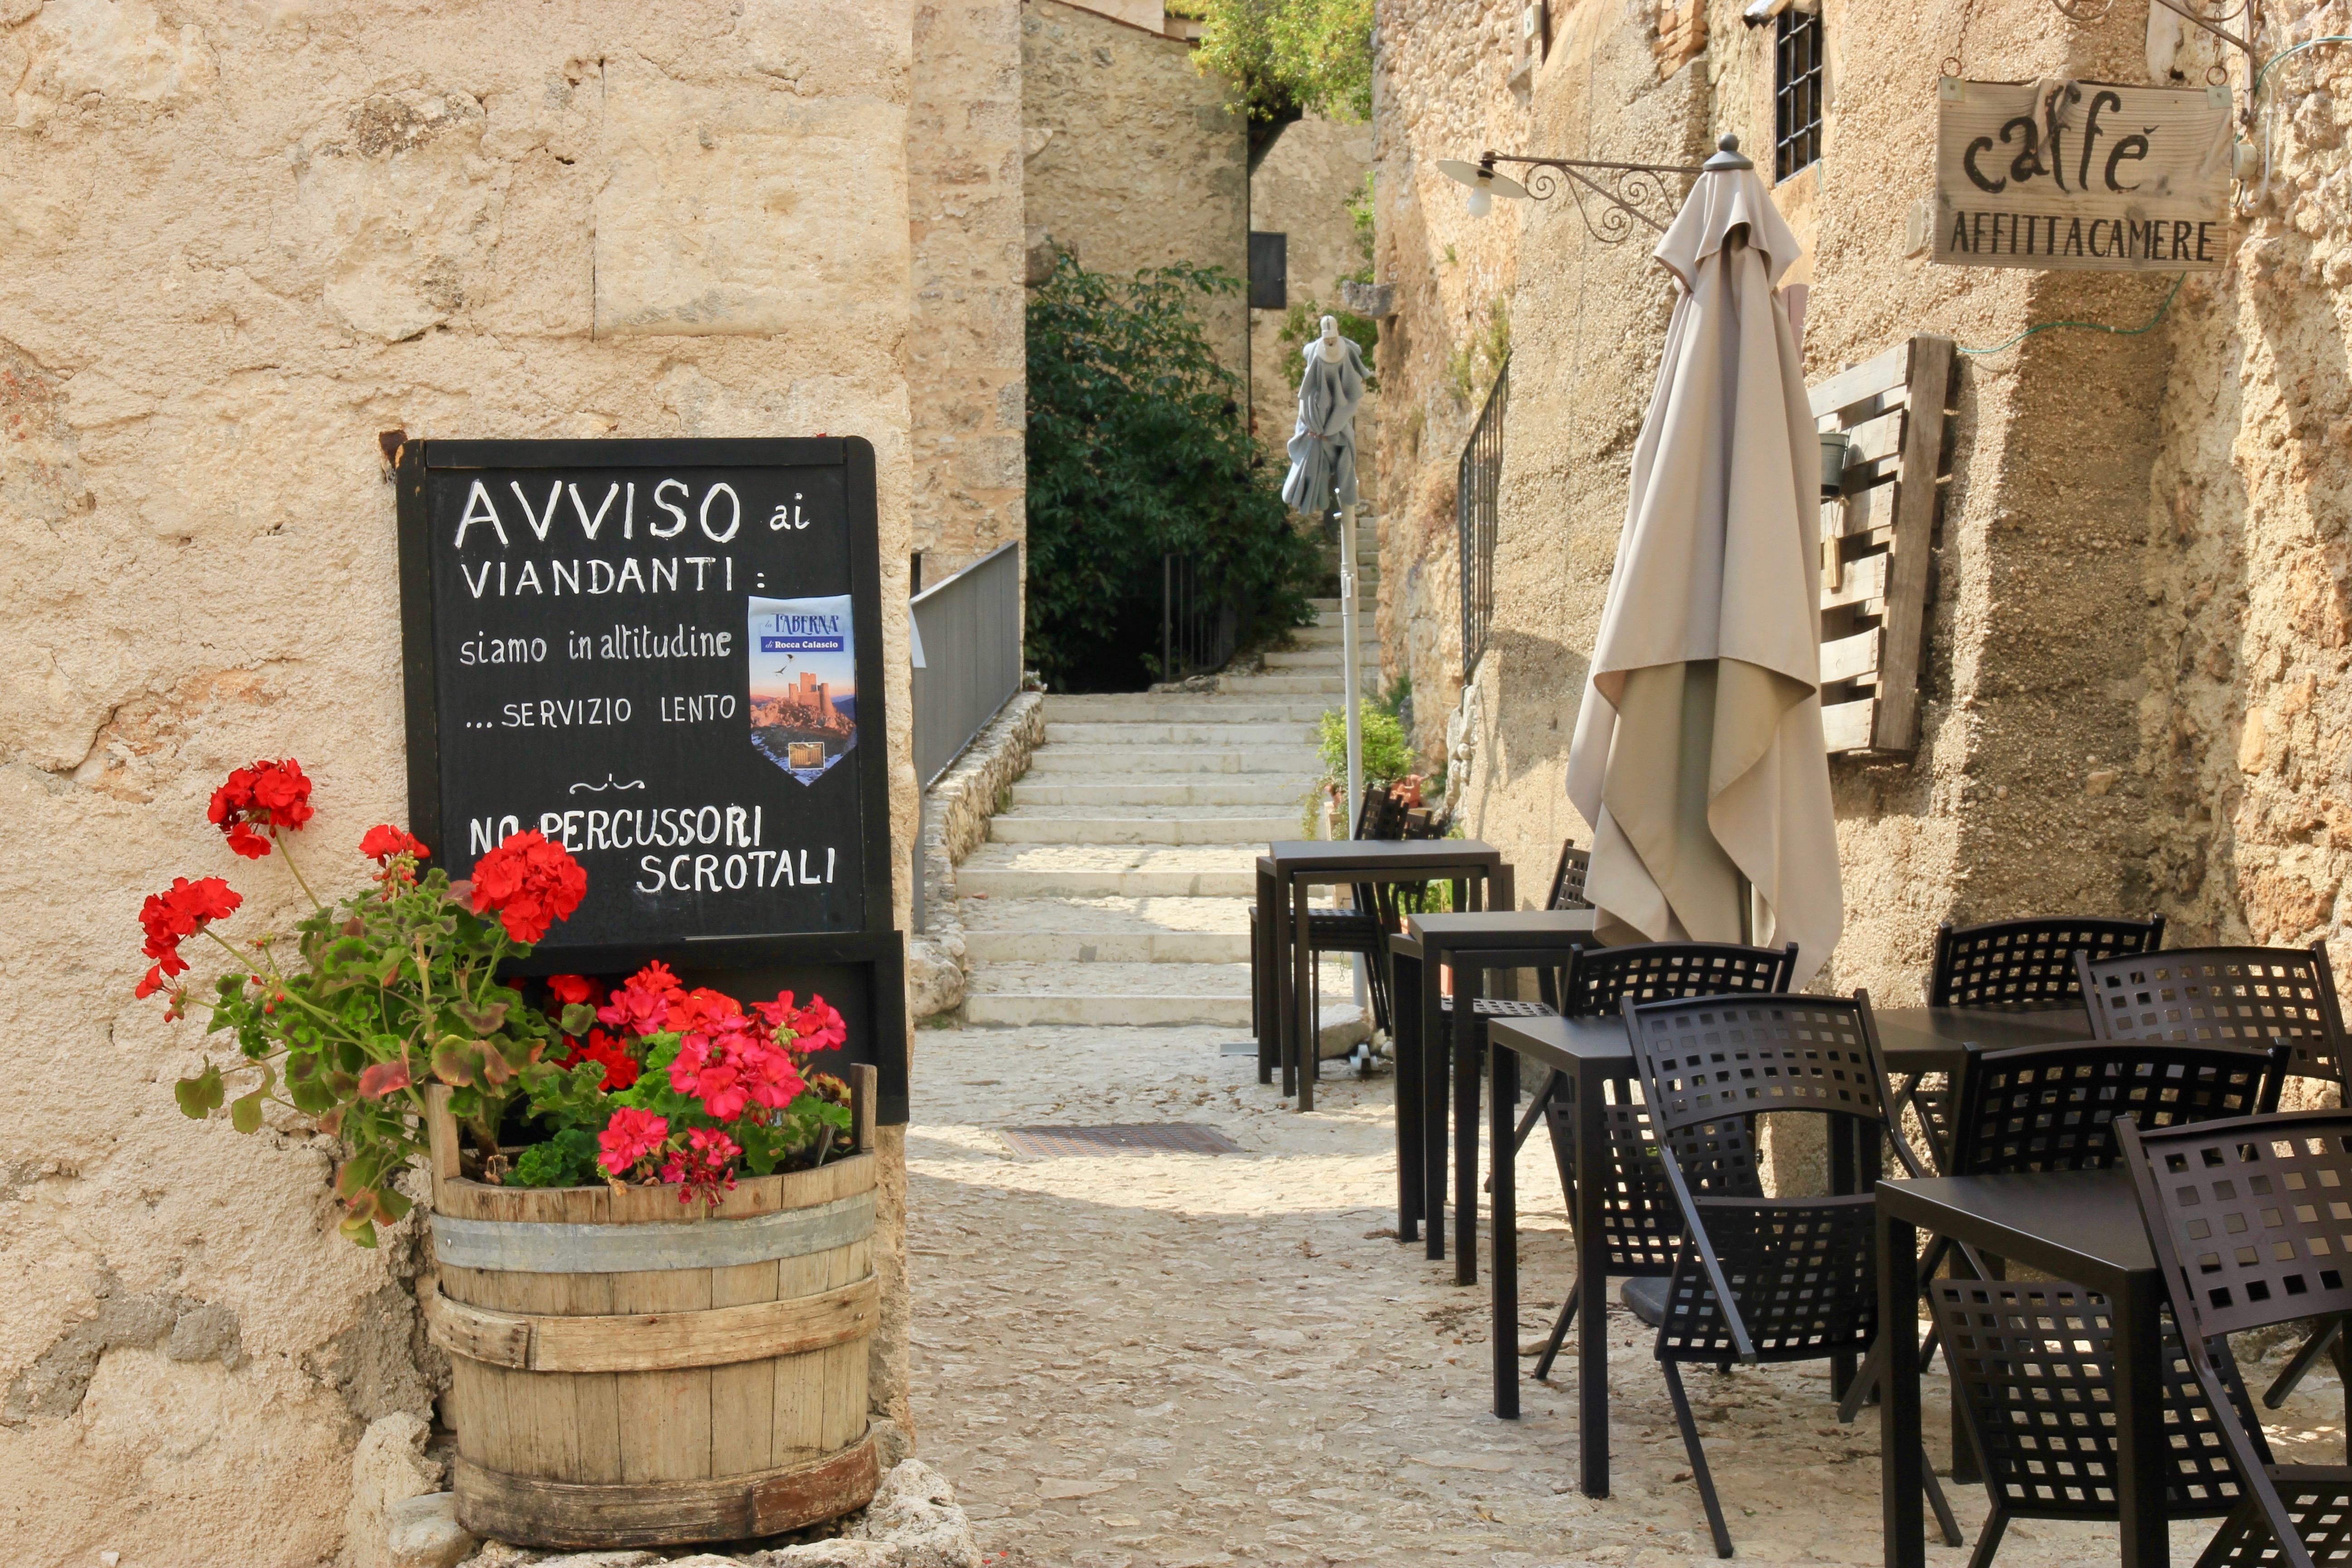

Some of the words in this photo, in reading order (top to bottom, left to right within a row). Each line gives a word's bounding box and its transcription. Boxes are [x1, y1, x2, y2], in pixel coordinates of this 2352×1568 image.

[1950, 211, 2217, 262] AFFITTACAMERE
[454, 478, 741, 549] AVVISO
[769, 493, 810, 531] ai
[460, 631, 547, 666] siamo
[569, 630, 592, 660] in
[600, 623, 732, 660] altitudine
[765, 640, 774, 649] di
[774, 641, 800, 649] Rocca
[802, 641, 838, 649] Calascio
[770, 613, 839, 635] TABERNA
[661, 694, 736, 723] LENTO
[470, 814, 519, 856] NO
[540, 805, 762, 853] PERCUSSORI
[636, 848, 836, 893] SCROTALI
